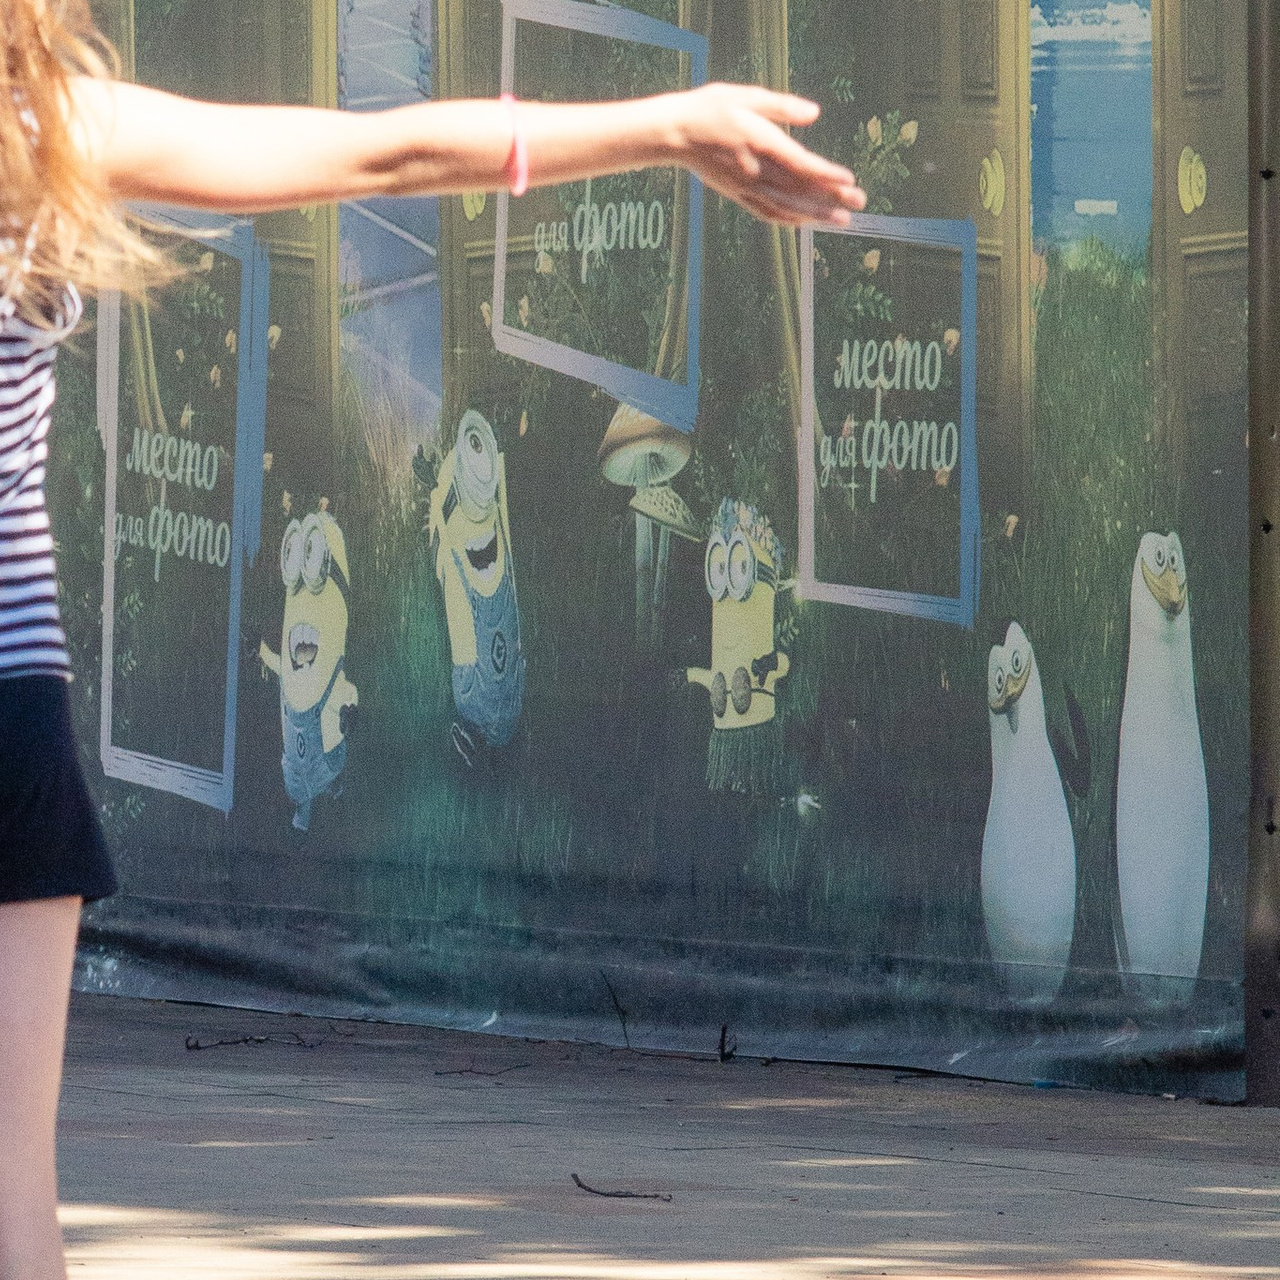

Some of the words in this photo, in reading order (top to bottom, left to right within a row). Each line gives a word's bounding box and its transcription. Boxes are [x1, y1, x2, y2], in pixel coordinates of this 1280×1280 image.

[573, 178, 664, 284] фото
[833, 339, 941, 391] место
[126, 427, 218, 490] место
[820, 435, 858, 488] для
[862, 387, 958, 503] фото
[148, 478, 230, 582] фото
